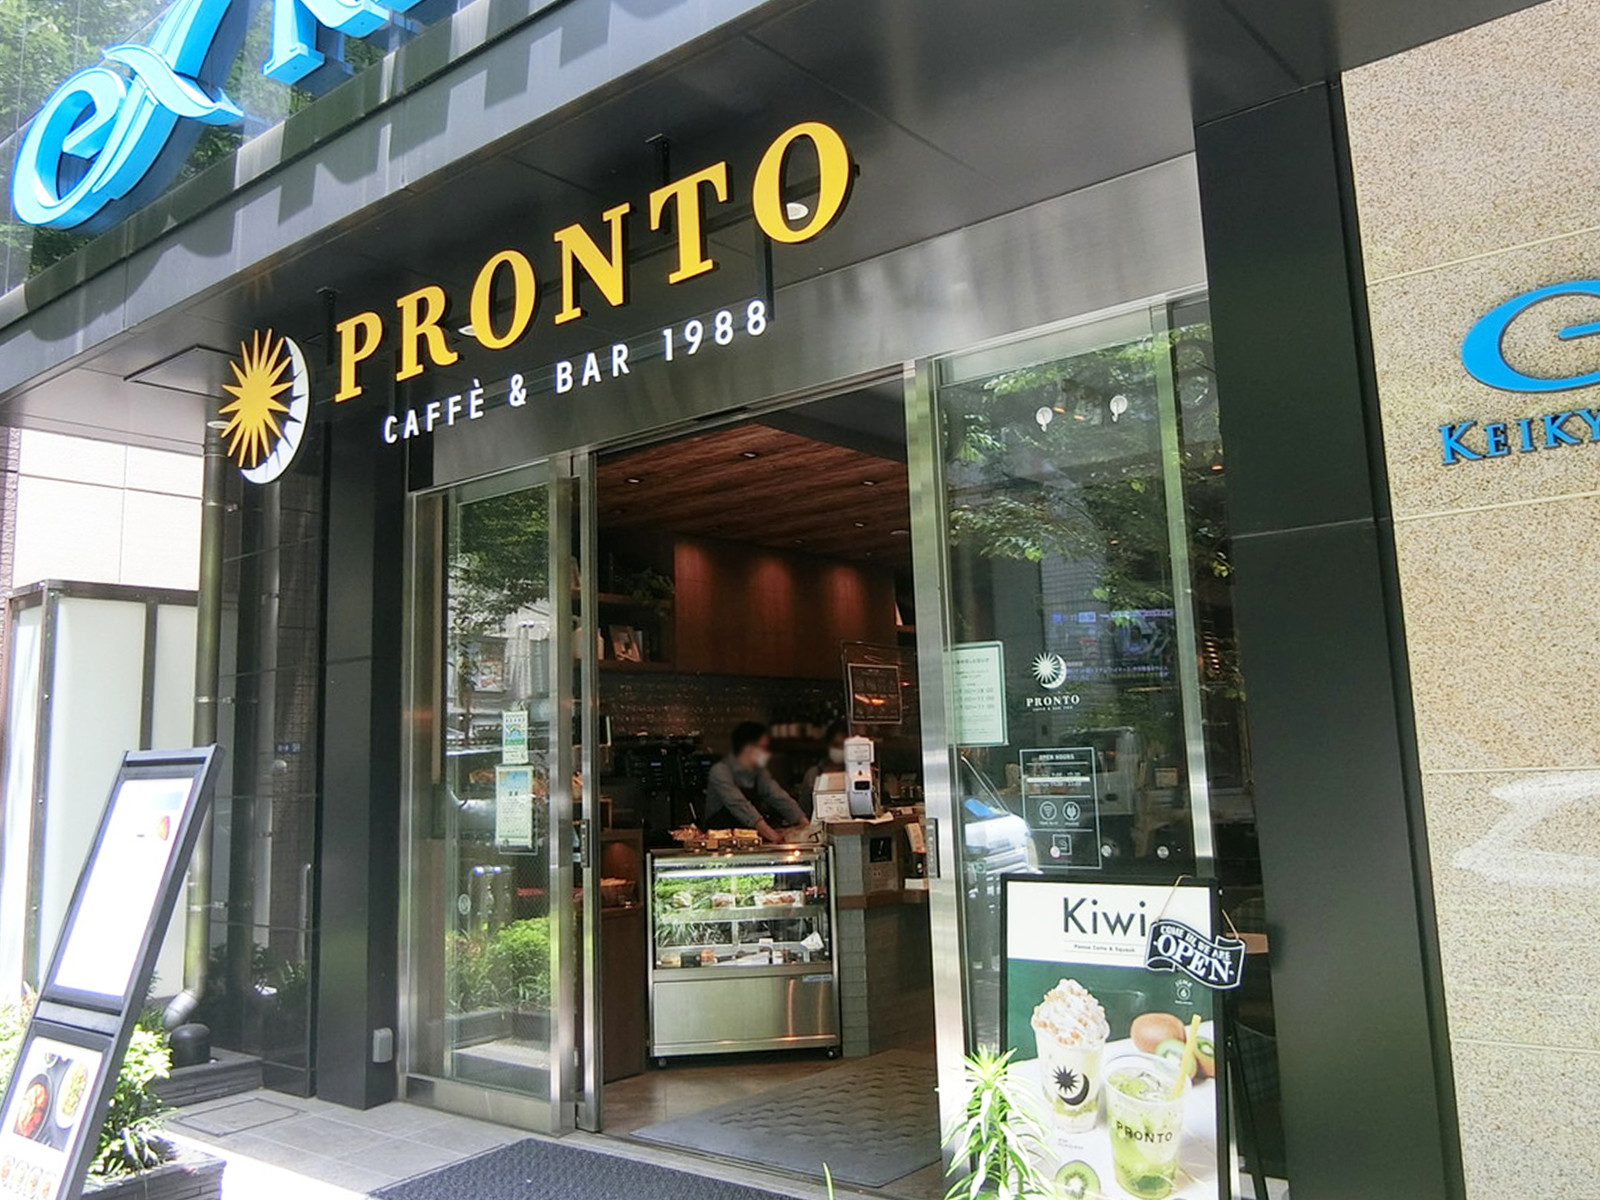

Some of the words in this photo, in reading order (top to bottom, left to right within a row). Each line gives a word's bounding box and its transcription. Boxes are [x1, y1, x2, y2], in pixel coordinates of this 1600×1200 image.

[333, 121, 851, 402] PRONTO
[383, 377, 485, 444] CAFFÈ
[508, 373, 528, 407] &
[555, 341, 631, 394] BAR
[662, 299, 768, 364] 1988
[1026, 694, 1080, 708] PRONTO
[1063, 897, 1146, 937] Kiwi
[1157, 934, 1233, 983] OPEN
[1160, 925, 1185, 938] COME
[1197, 941, 1212, 955] WE
[1211, 948, 1231, 961] ARE
[1115, 1120, 1173, 1143] PRONTO
